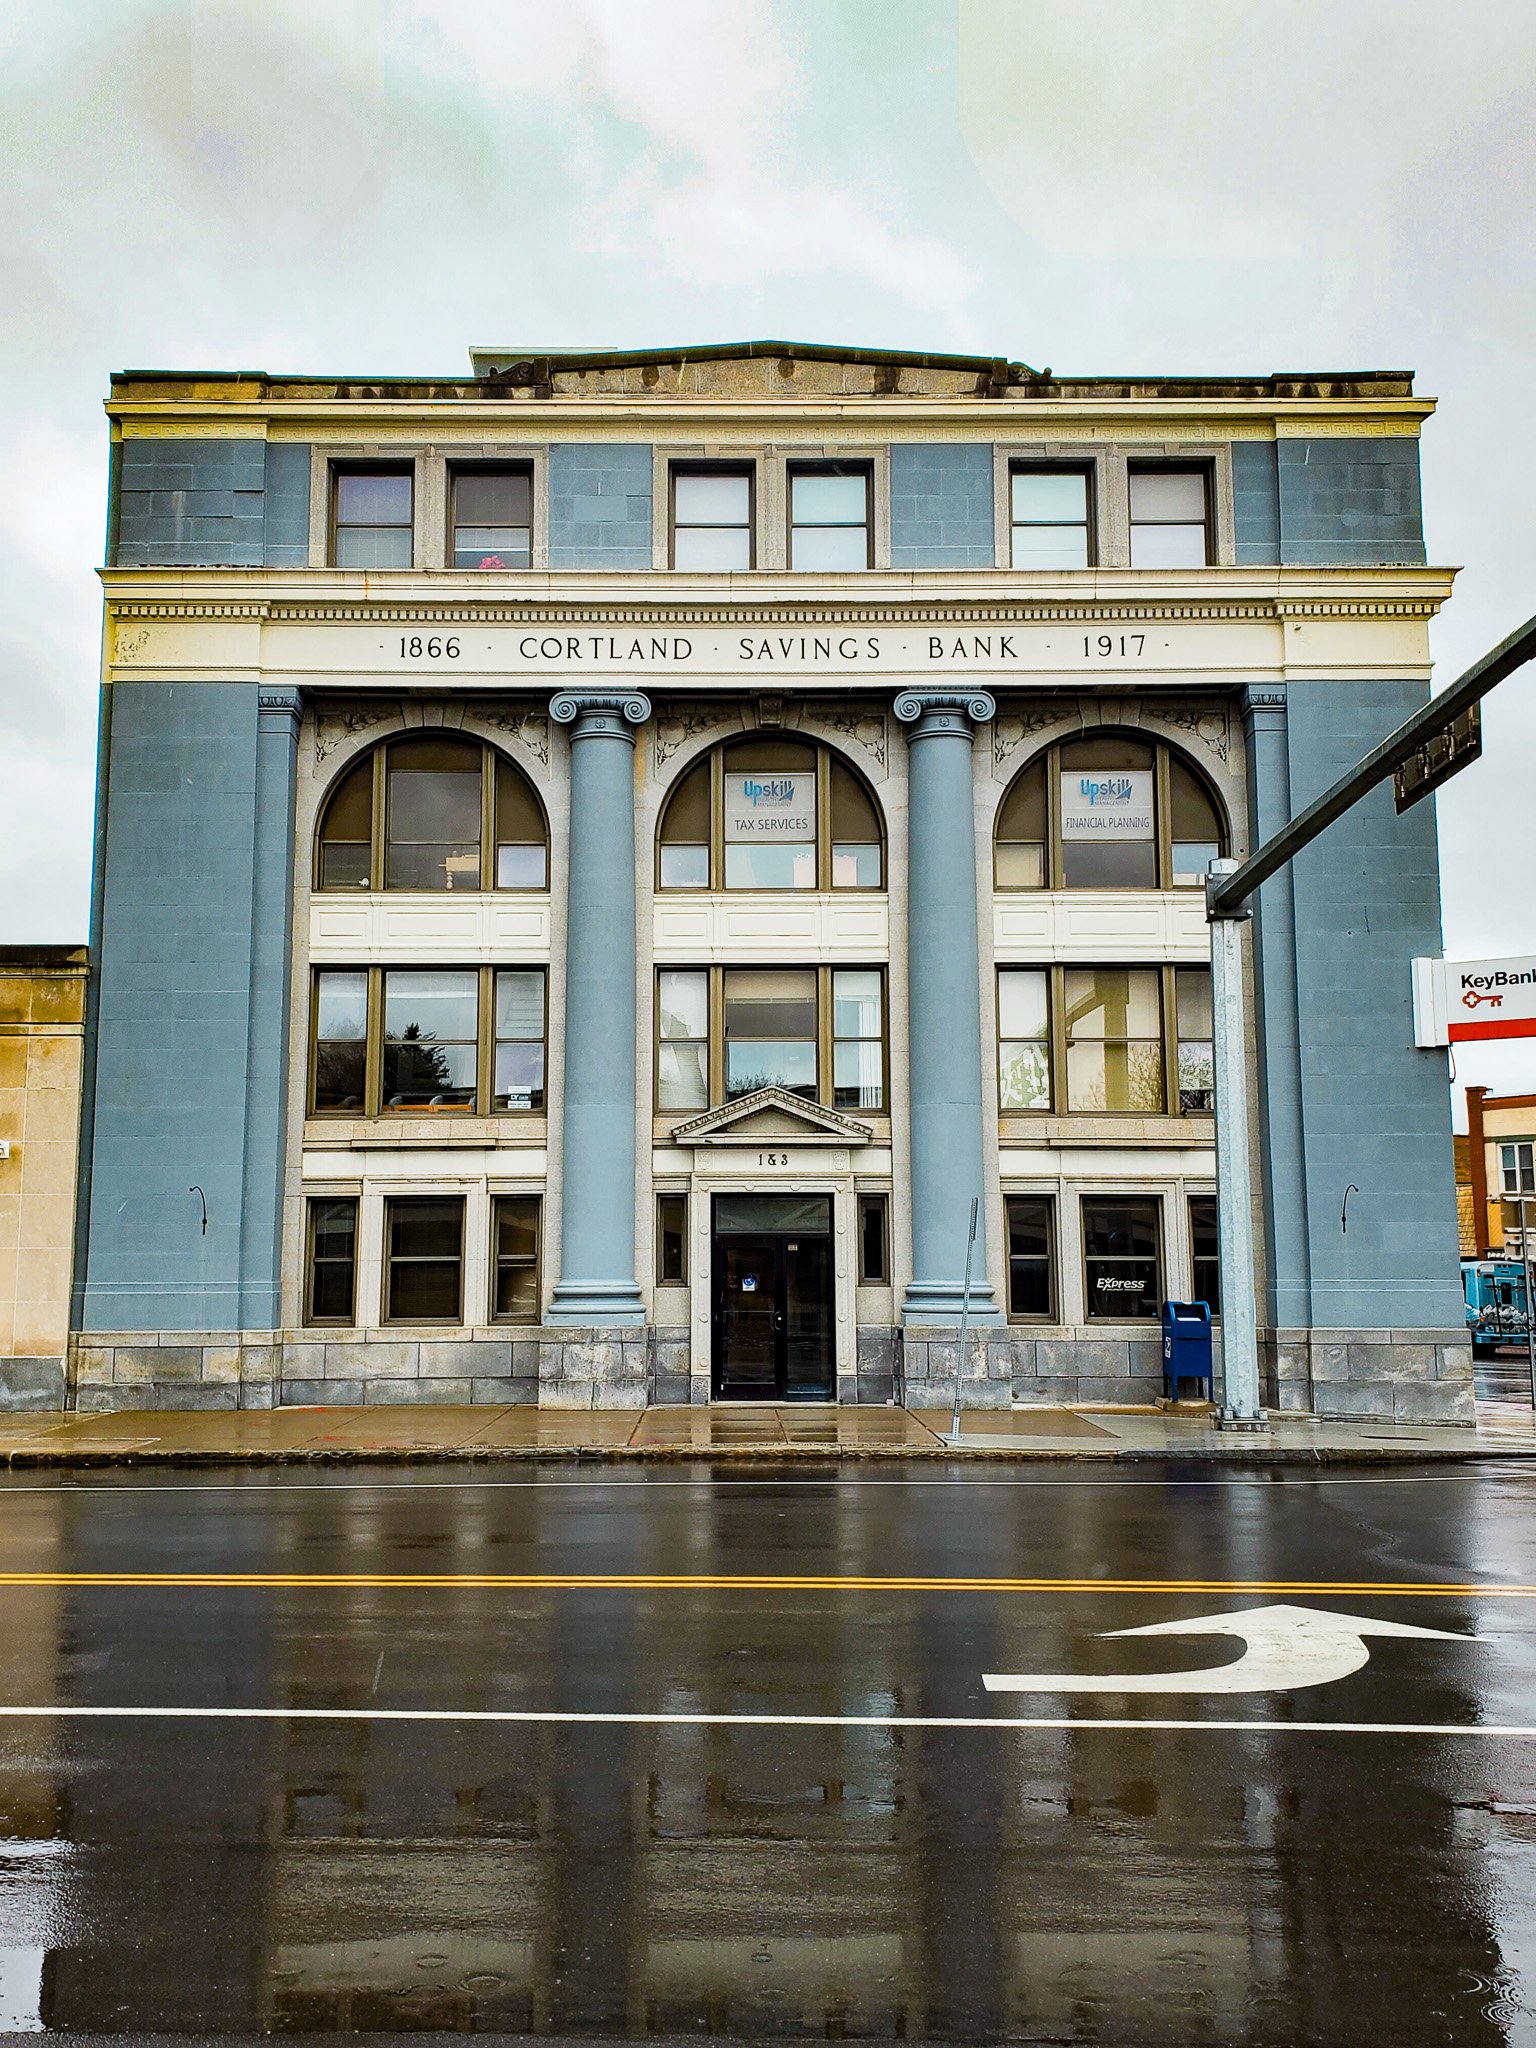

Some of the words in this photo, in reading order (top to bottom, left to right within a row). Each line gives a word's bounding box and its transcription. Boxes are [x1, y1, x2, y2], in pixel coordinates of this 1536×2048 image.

[400, 637, 460, 659] 1866
[519, 637, 692, 660] CORTLAND
[739, 637, 881, 660] SAVINGS
[928, 636, 1019, 659] BANK
[1084, 635, 1146, 657] 1917
[743, 780, 793, 807] Upskill
[1081, 779, 1131, 805] Upskill
[735, 819, 755, 831] TAX
[758, 818, 808, 830] SERVICES
[1066, 817, 1107, 829] FINANCIAL
[1108, 816, 1150, 828] PLANNING
[758, 1153, 763, 1166] 1
[767, 1153, 777, 1166] &
[781, 1153, 788, 1166] 3
